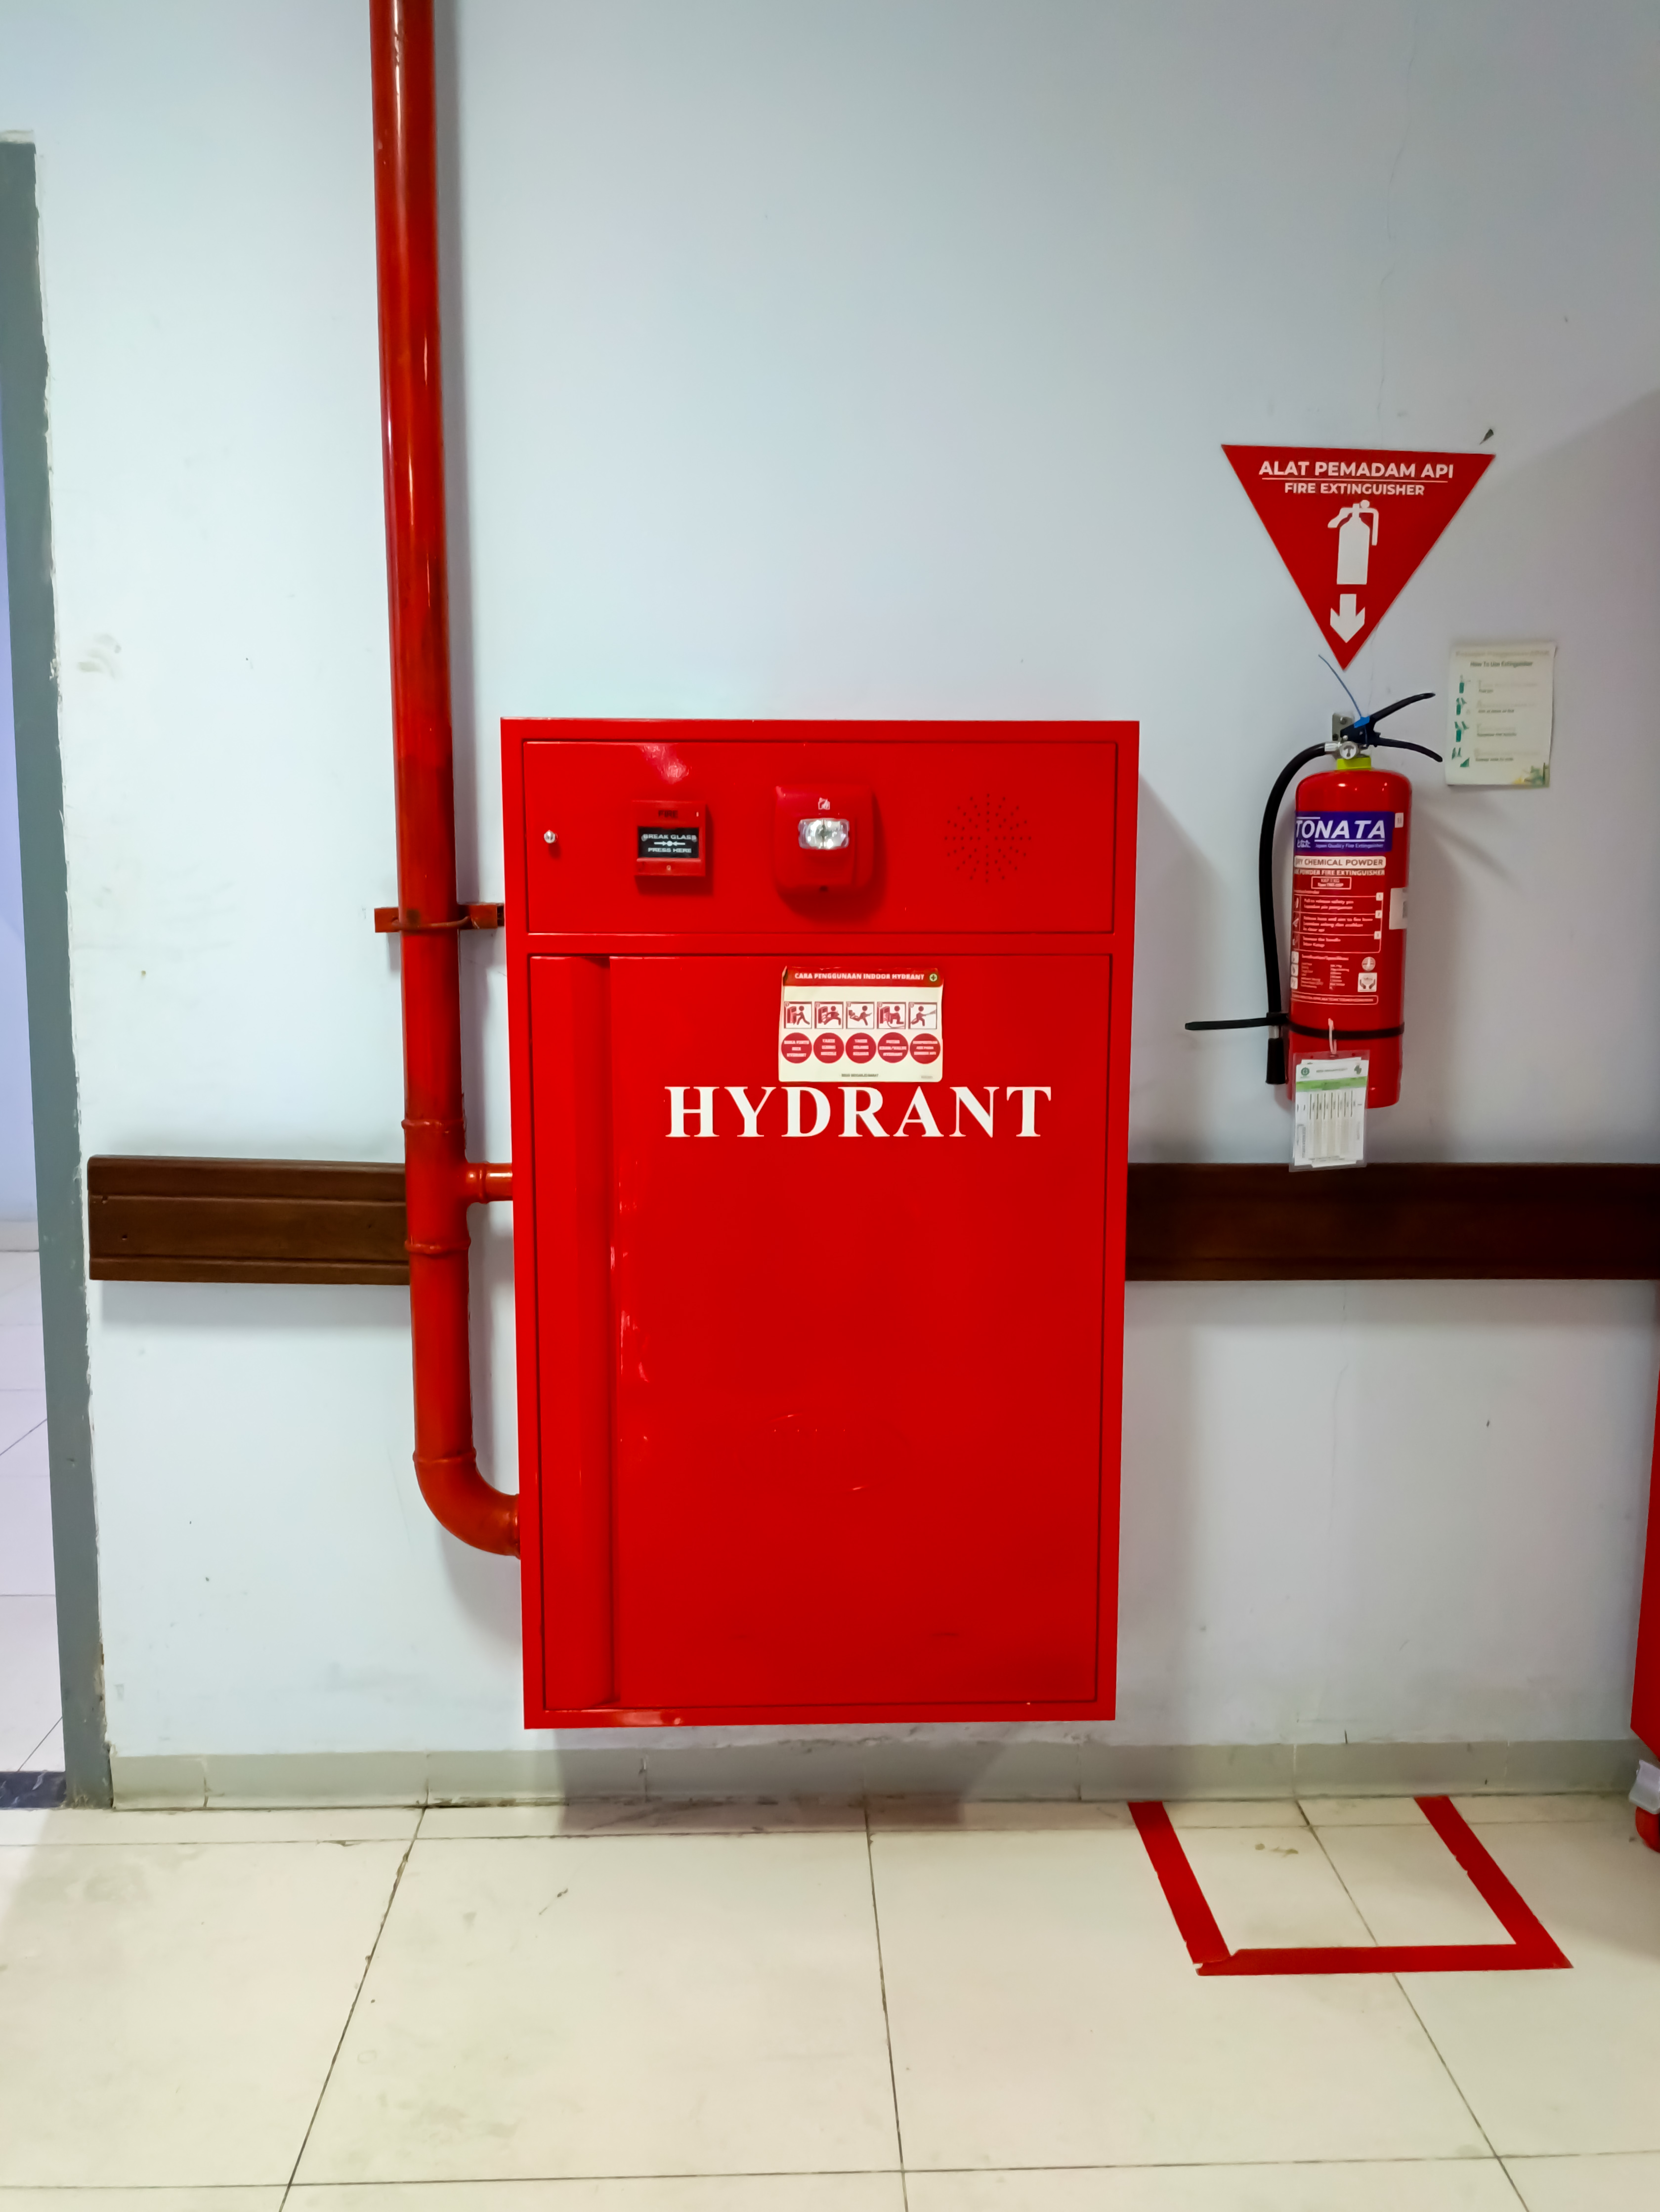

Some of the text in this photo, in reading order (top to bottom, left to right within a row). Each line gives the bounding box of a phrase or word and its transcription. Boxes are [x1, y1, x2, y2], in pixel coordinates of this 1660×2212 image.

[1259, 461, 1454, 479] ALAT PEMADAM API
[1284, 482, 1425, 496] FIRE EXTINGUISHER
[658, 810, 679, 818] FIRE
[1296, 820, 1385, 839] TONATA
[664, 1085, 1052, 1138] HYDRANT
